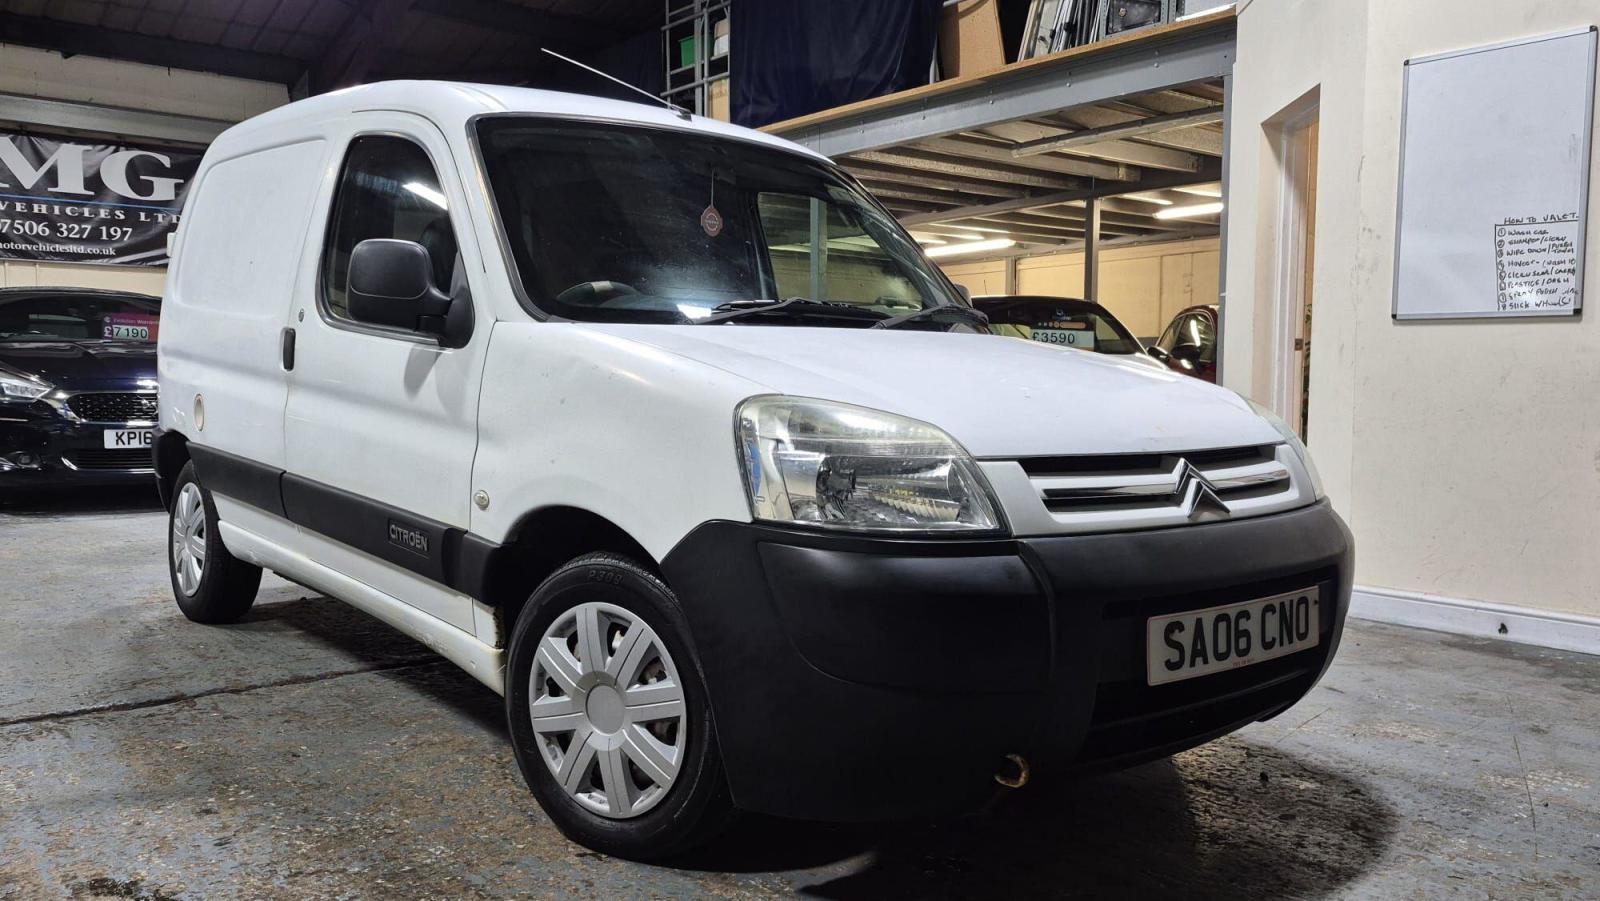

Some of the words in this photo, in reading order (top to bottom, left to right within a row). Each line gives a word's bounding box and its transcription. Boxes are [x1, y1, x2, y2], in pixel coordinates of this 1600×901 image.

[1503, 216, 1524, 225] HOW
[0, 219, 50, 236] 7506
[56, 222, 92, 239] 327
[99, 226, 132, 241] 197
[0, 241, 116, 256] otorvehiclesltd.co.uk
[1032, 332, 1075, 344] £3590
[115, 431, 153, 446] KP16
[389, 524, 428, 552] CITROËN
[1163, 609, 1251, 671] SA06
[1261, 595, 1309, 651] CNO
